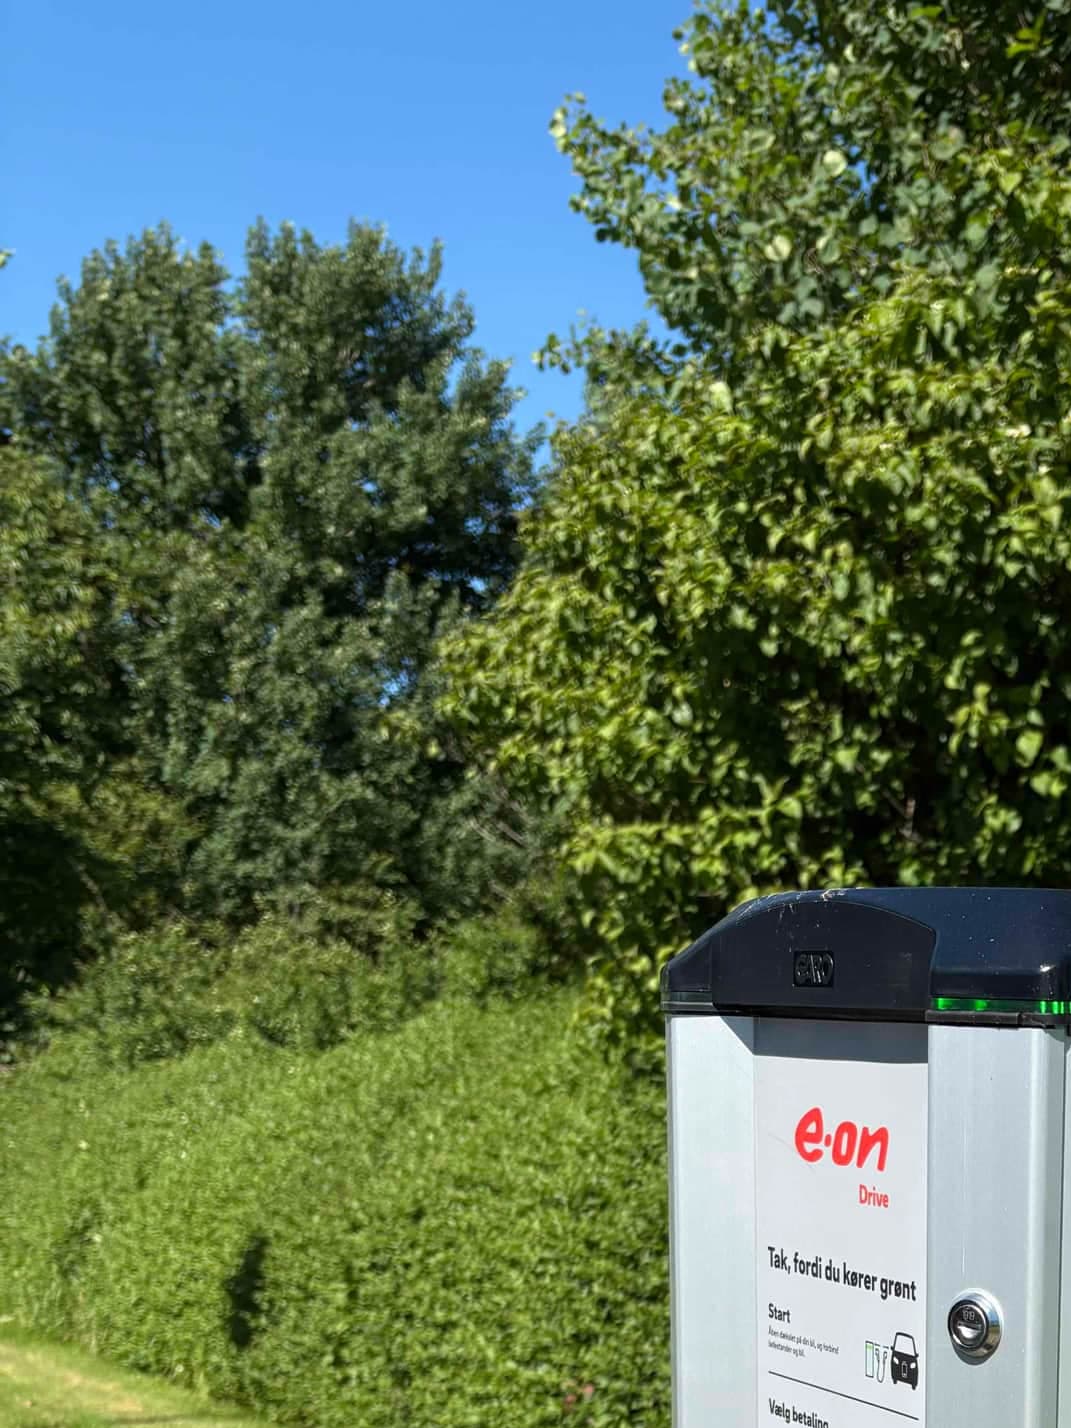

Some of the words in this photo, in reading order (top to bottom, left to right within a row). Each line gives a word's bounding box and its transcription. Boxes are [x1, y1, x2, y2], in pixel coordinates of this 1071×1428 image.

[859, 1184, 889, 1208] Drive
[768, 1246, 791, 1274] Tak,
[793, 1252, 822, 1278] fordi
[825, 1259, 840, 1283] du
[843, 1262, 877, 1291] kører
[880, 1277, 917, 1301] grønt
[768, 1303, 791, 1323] Start
[769, 1398, 791, 1423] Vælg
